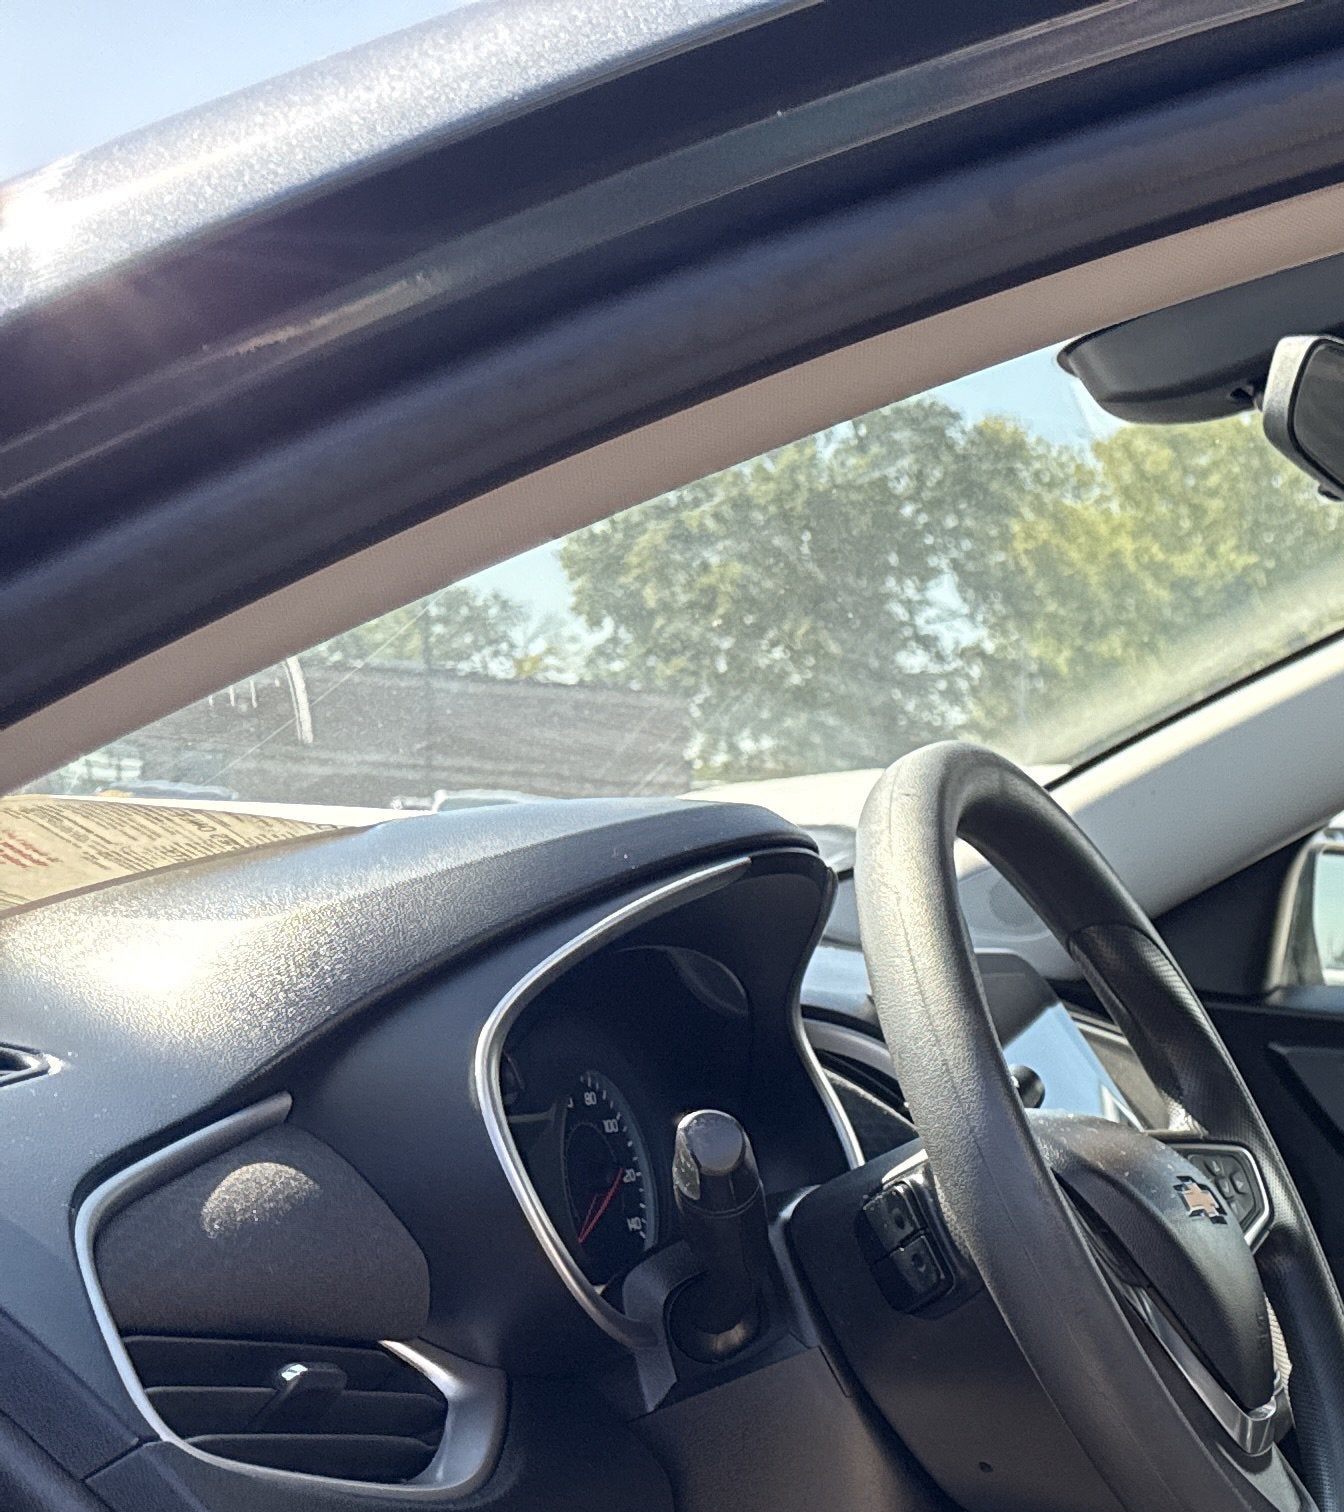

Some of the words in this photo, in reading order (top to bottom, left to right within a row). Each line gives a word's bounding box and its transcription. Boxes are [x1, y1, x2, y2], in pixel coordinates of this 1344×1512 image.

[583, 1090, 597, 1106] 80
[602, 1118, 620, 1133] 100
[626, 1216, 643, 1231] 140
